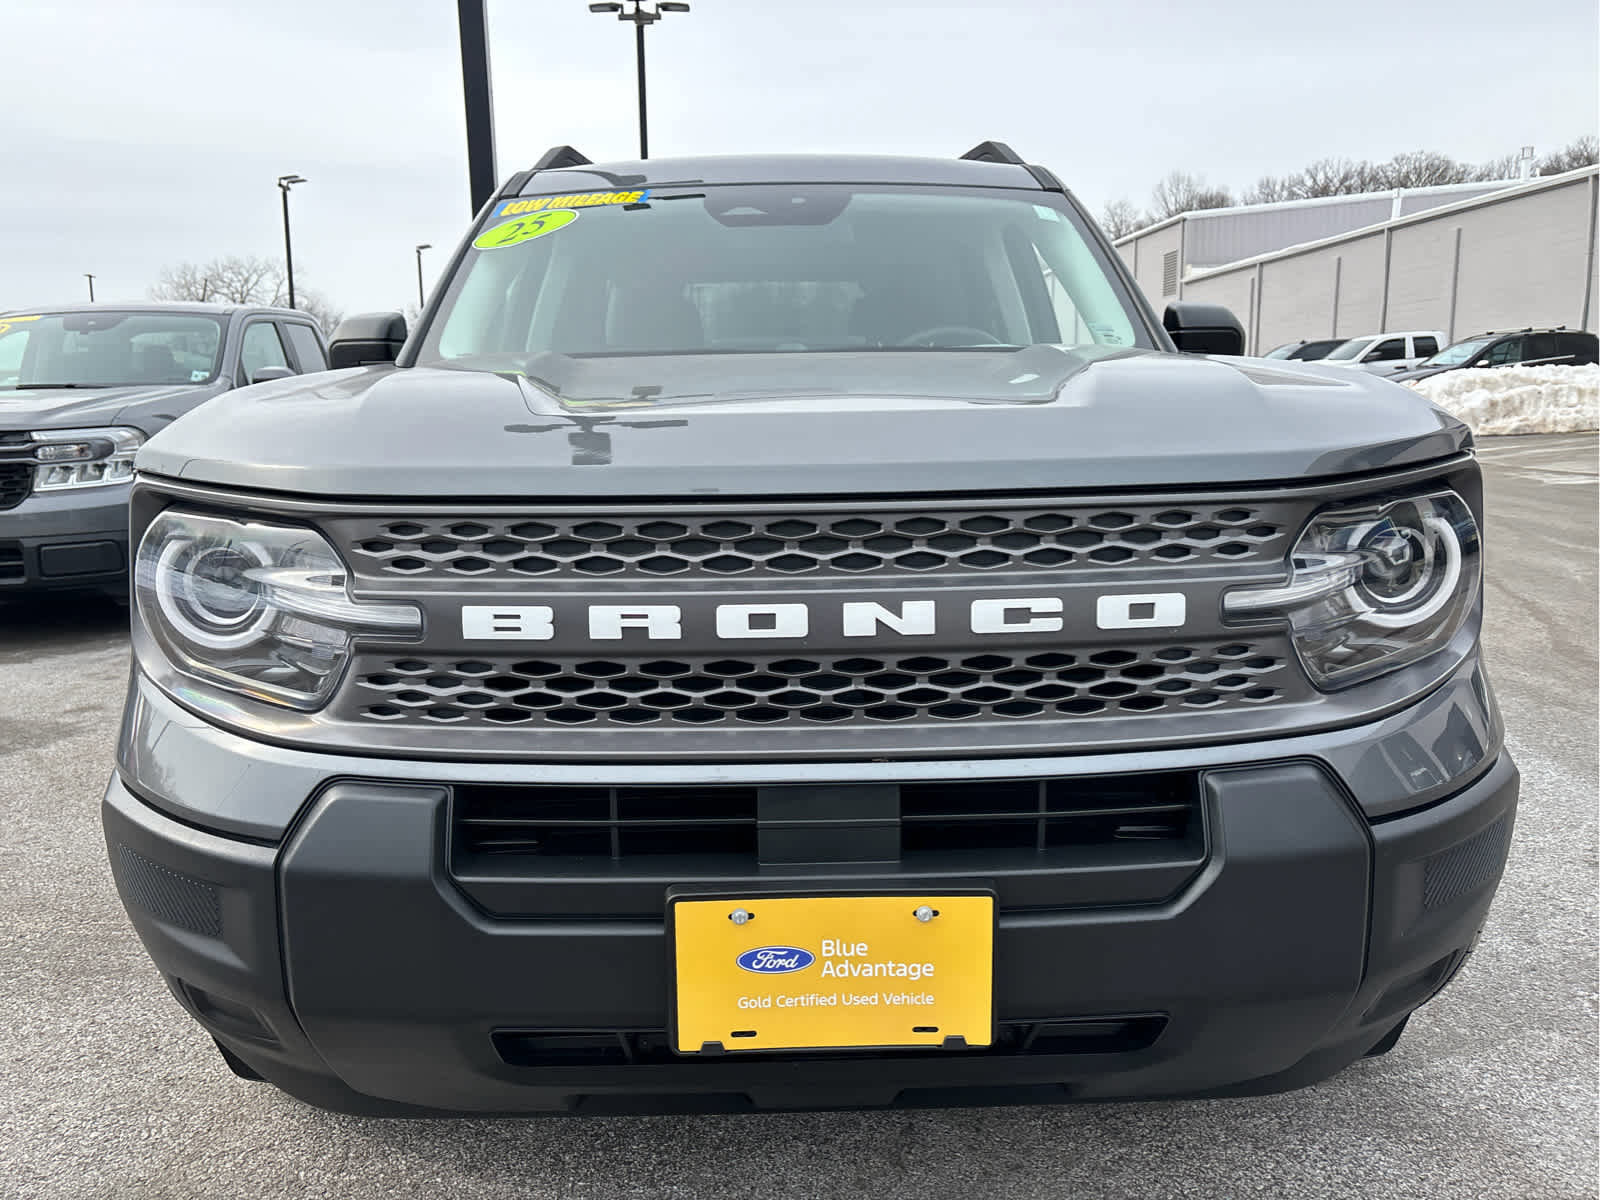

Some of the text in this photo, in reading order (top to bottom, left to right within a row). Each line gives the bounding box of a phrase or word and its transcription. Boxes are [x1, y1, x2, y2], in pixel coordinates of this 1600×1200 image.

[500, 190, 646, 217] LOW MILEAGE
[496, 213, 552, 244] 25
[462, 592, 1186, 640] BRONCO
[821, 939, 868, 957] Blue
[752, 950, 799, 969] Ford
[821, 960, 935, 980] Advantage
[737, 991, 935, 1009] Gold Certified Used Vehicle
